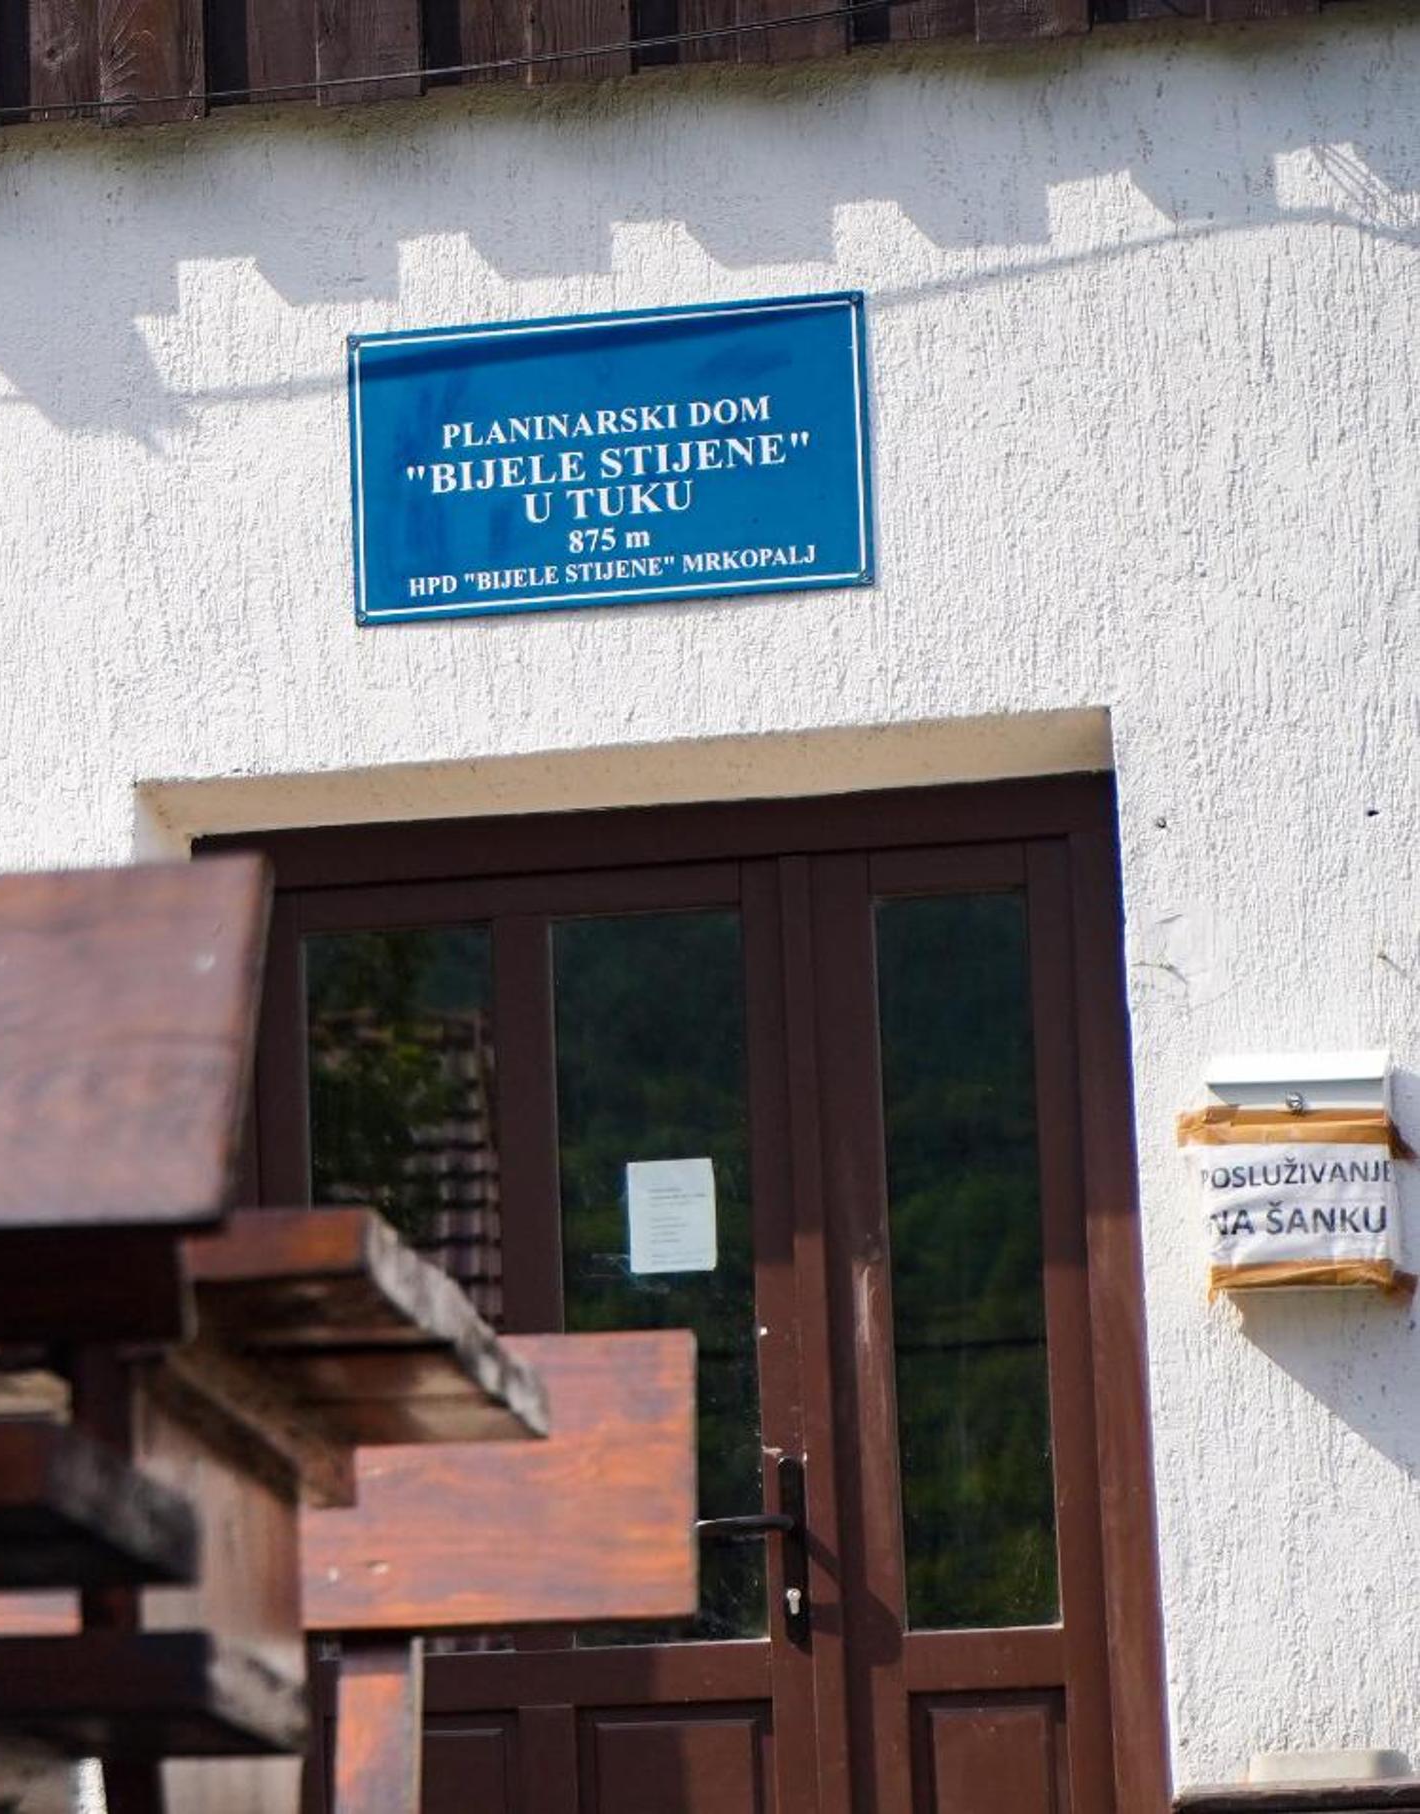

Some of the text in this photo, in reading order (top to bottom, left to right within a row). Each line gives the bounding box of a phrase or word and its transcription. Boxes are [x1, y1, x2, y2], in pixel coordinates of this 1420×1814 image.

[442, 395, 771, 449] PLANINARSKI DOM
[406, 430, 811, 494] "BIJELE STIJENE"
[524, 480, 694, 524] U TUKU
[568, 528, 651, 554] 875 m
[409, 544, 818, 598] HPD "BIJELE STIJENE" MRKOPALJ
[1266, 1201, 1388, 1234] ŠANKU
